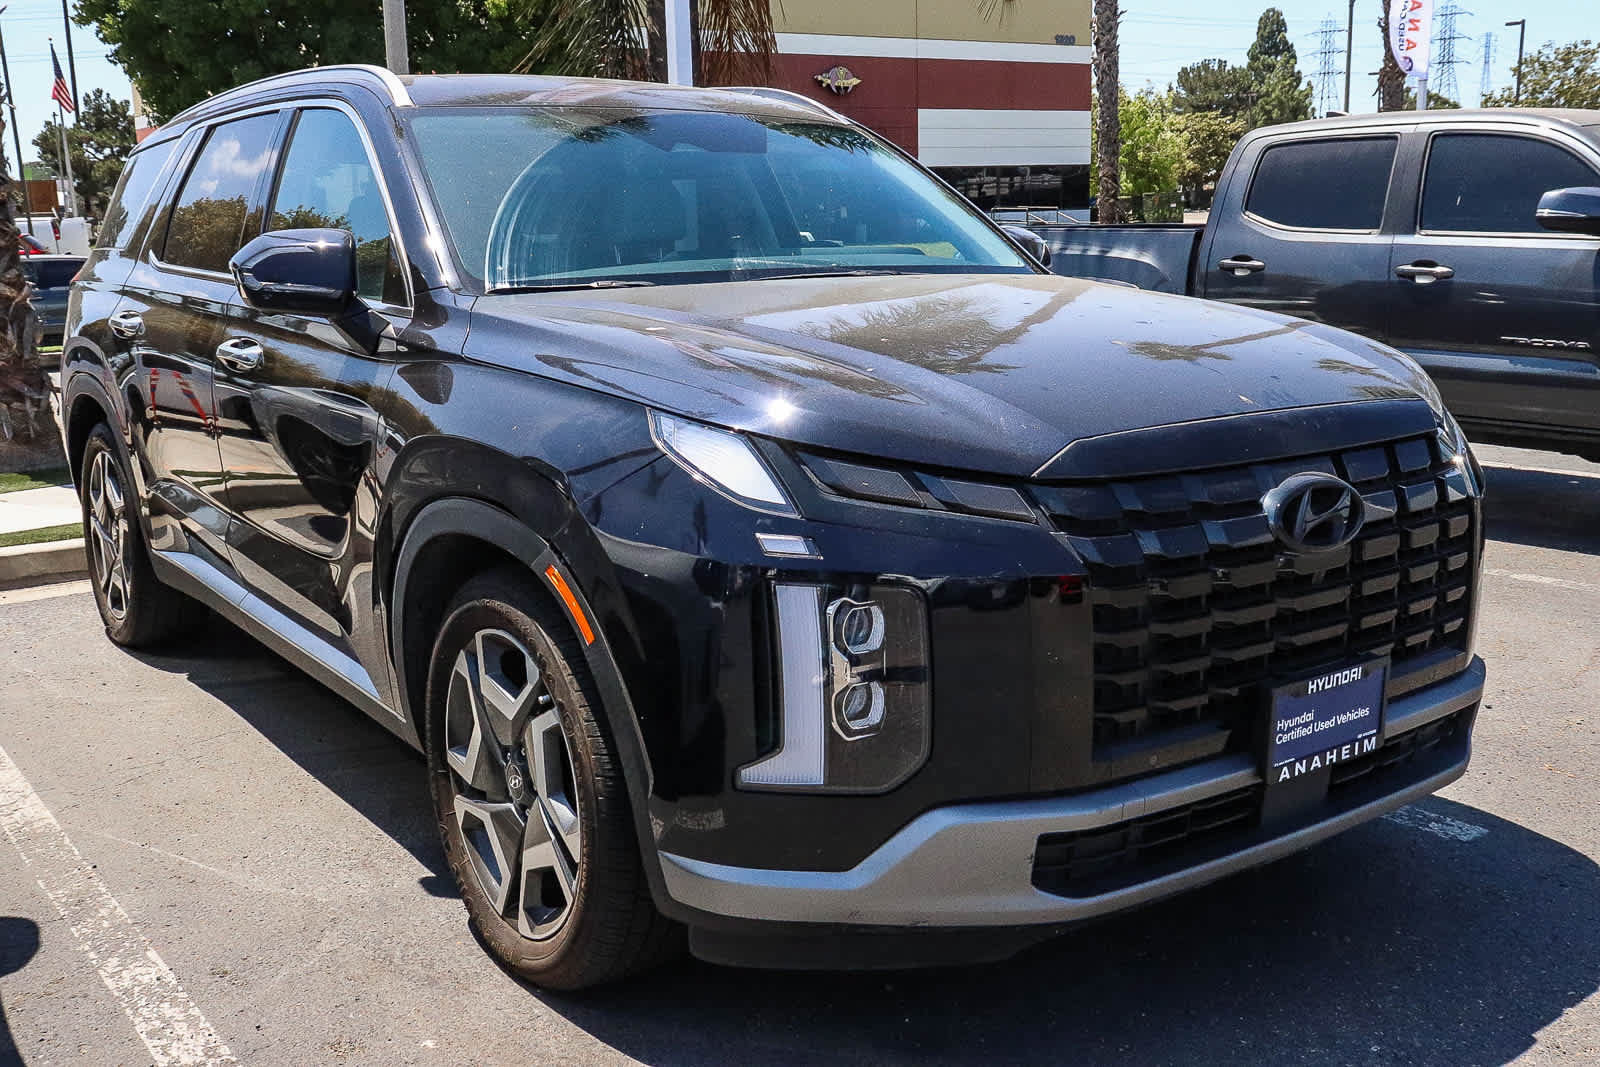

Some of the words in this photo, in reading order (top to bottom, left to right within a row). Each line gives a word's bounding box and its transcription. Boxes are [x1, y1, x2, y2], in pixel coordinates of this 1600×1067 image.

[1308, 666, 1362, 694] HYUNDAI
[1275, 725, 1313, 745] Certified
[1313, 717, 1335, 732] Used
[1337, 706, 1370, 724] Vehicles
[1276, 709, 1314, 731] Hyundai
[1278, 736, 1377, 782] ANAHEIM
